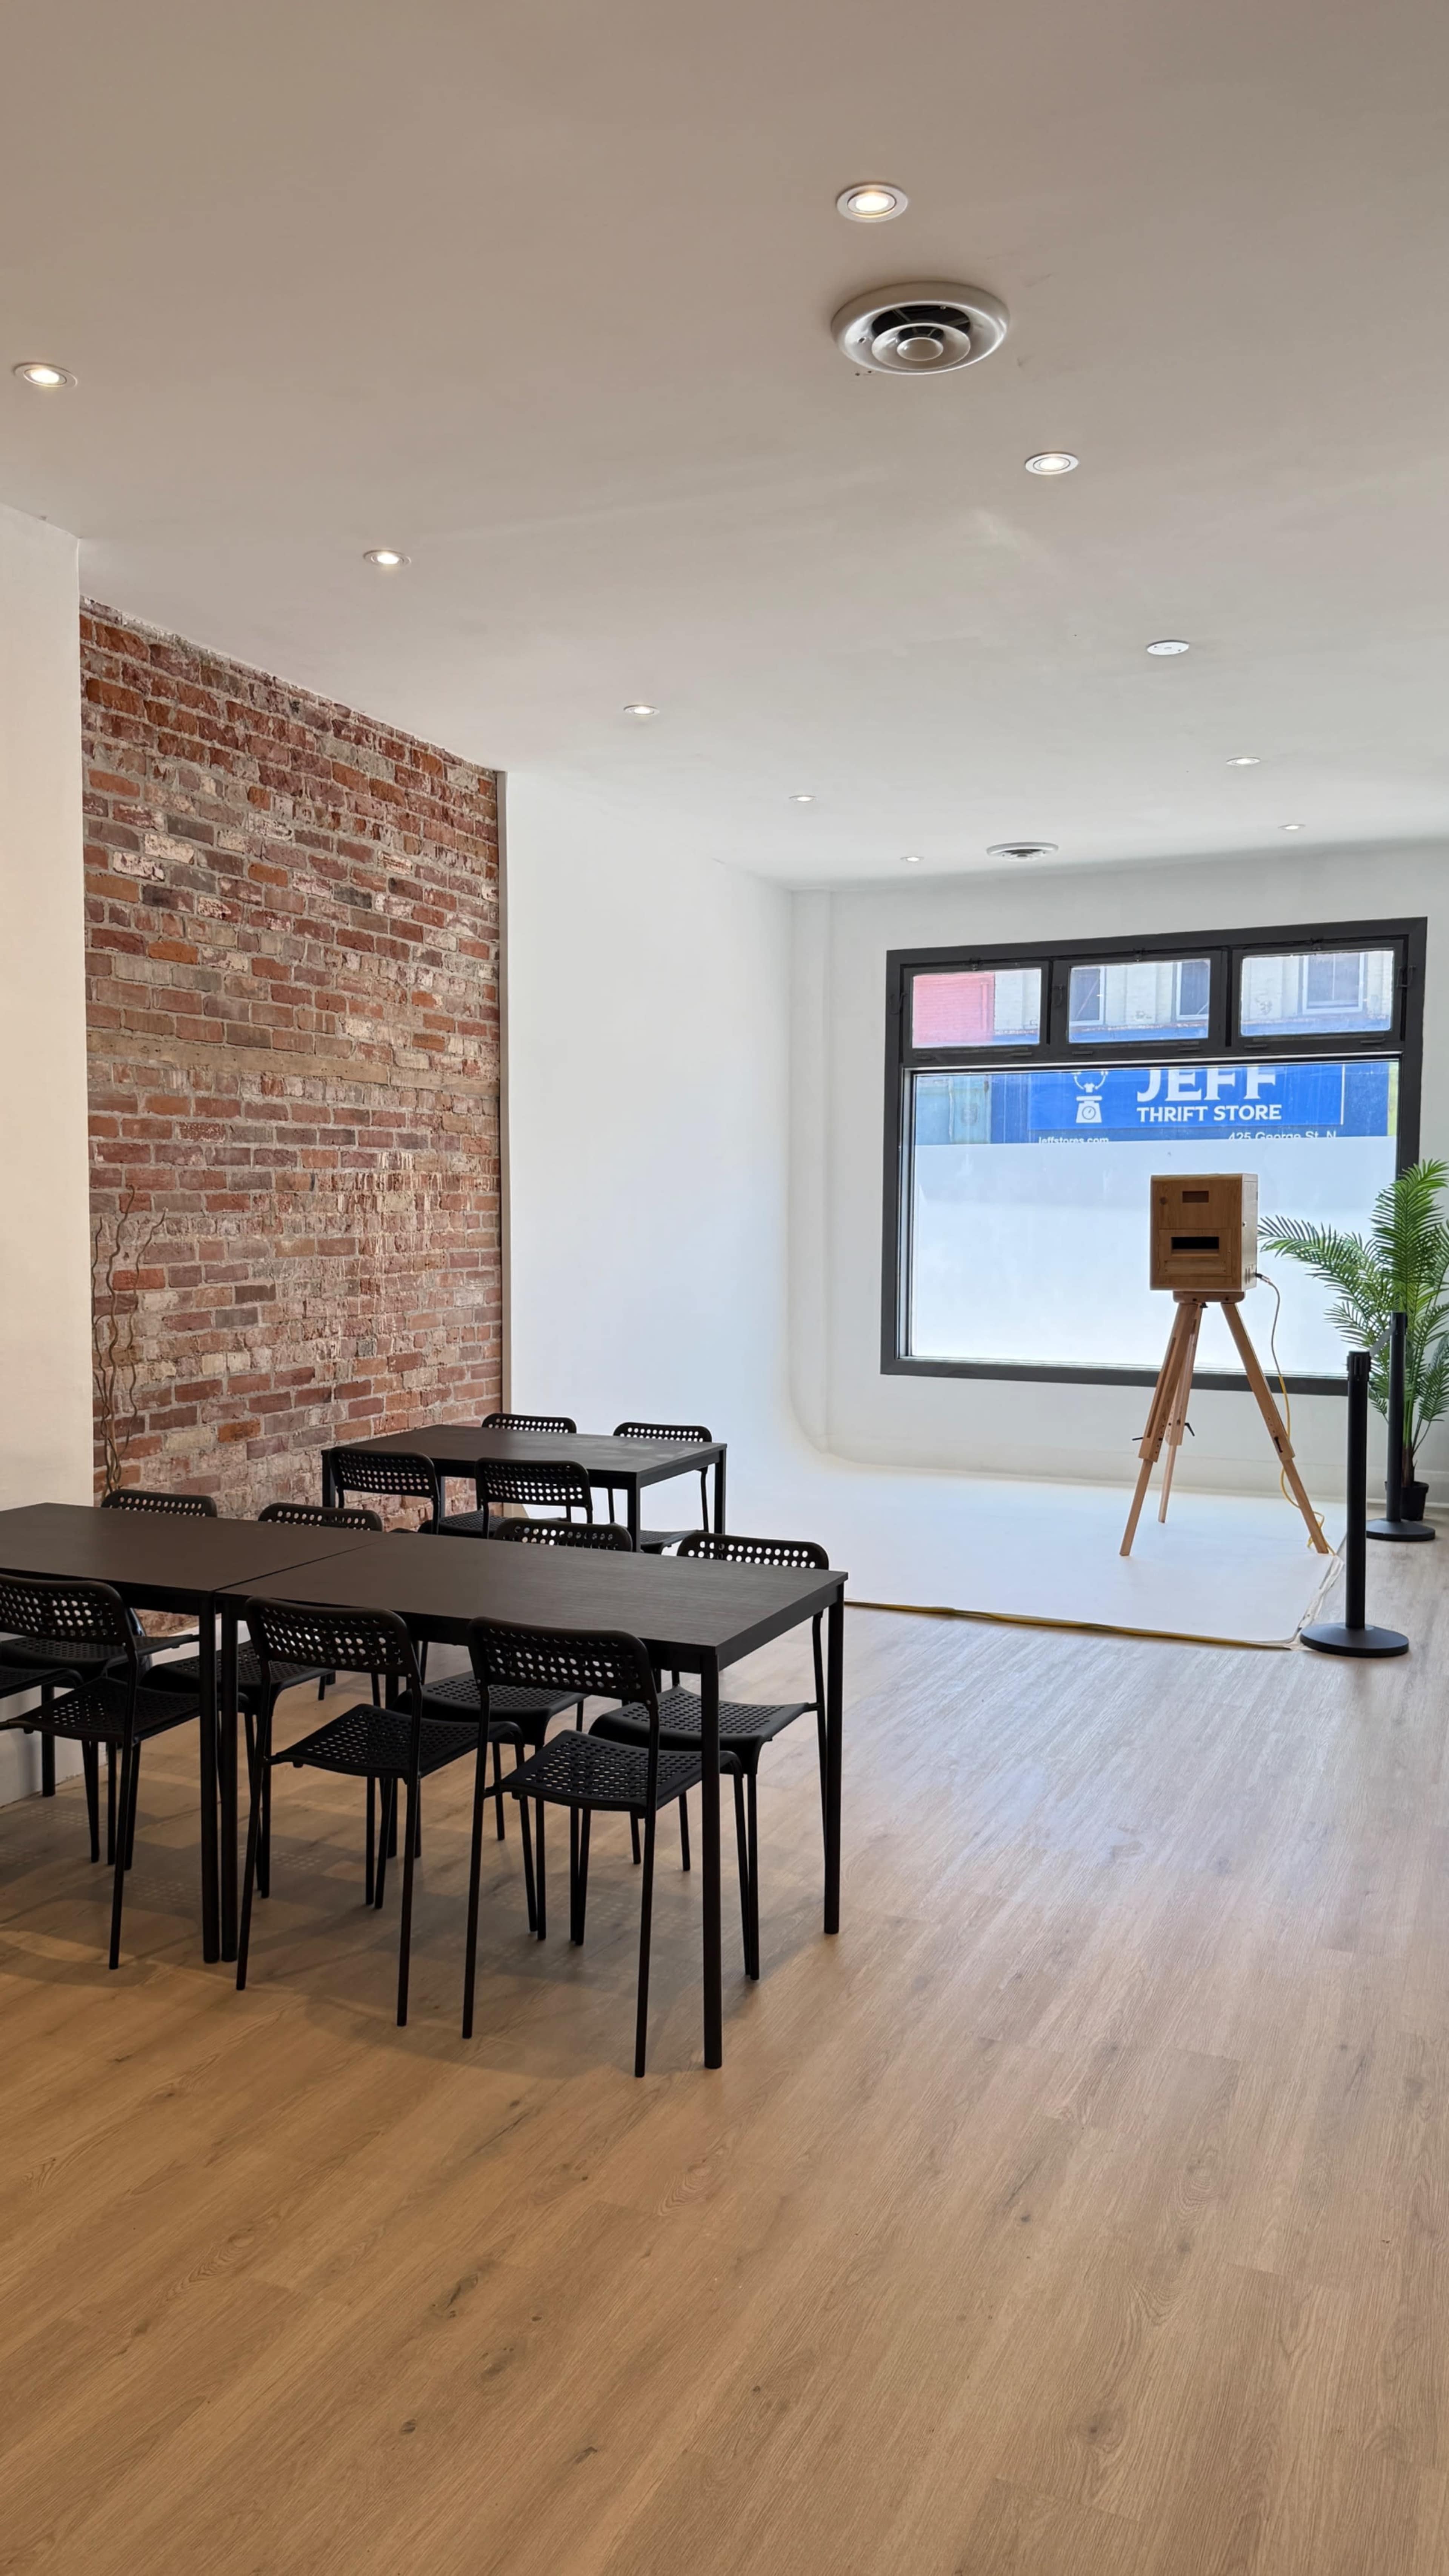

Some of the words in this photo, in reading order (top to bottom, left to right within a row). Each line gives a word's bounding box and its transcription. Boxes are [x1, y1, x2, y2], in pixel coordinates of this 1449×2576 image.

[1137, 1066, 1276, 1102] JEFF
[1137, 1106, 1208, 1122] THRIFT
[1214, 1104, 1282, 1121] STORE
